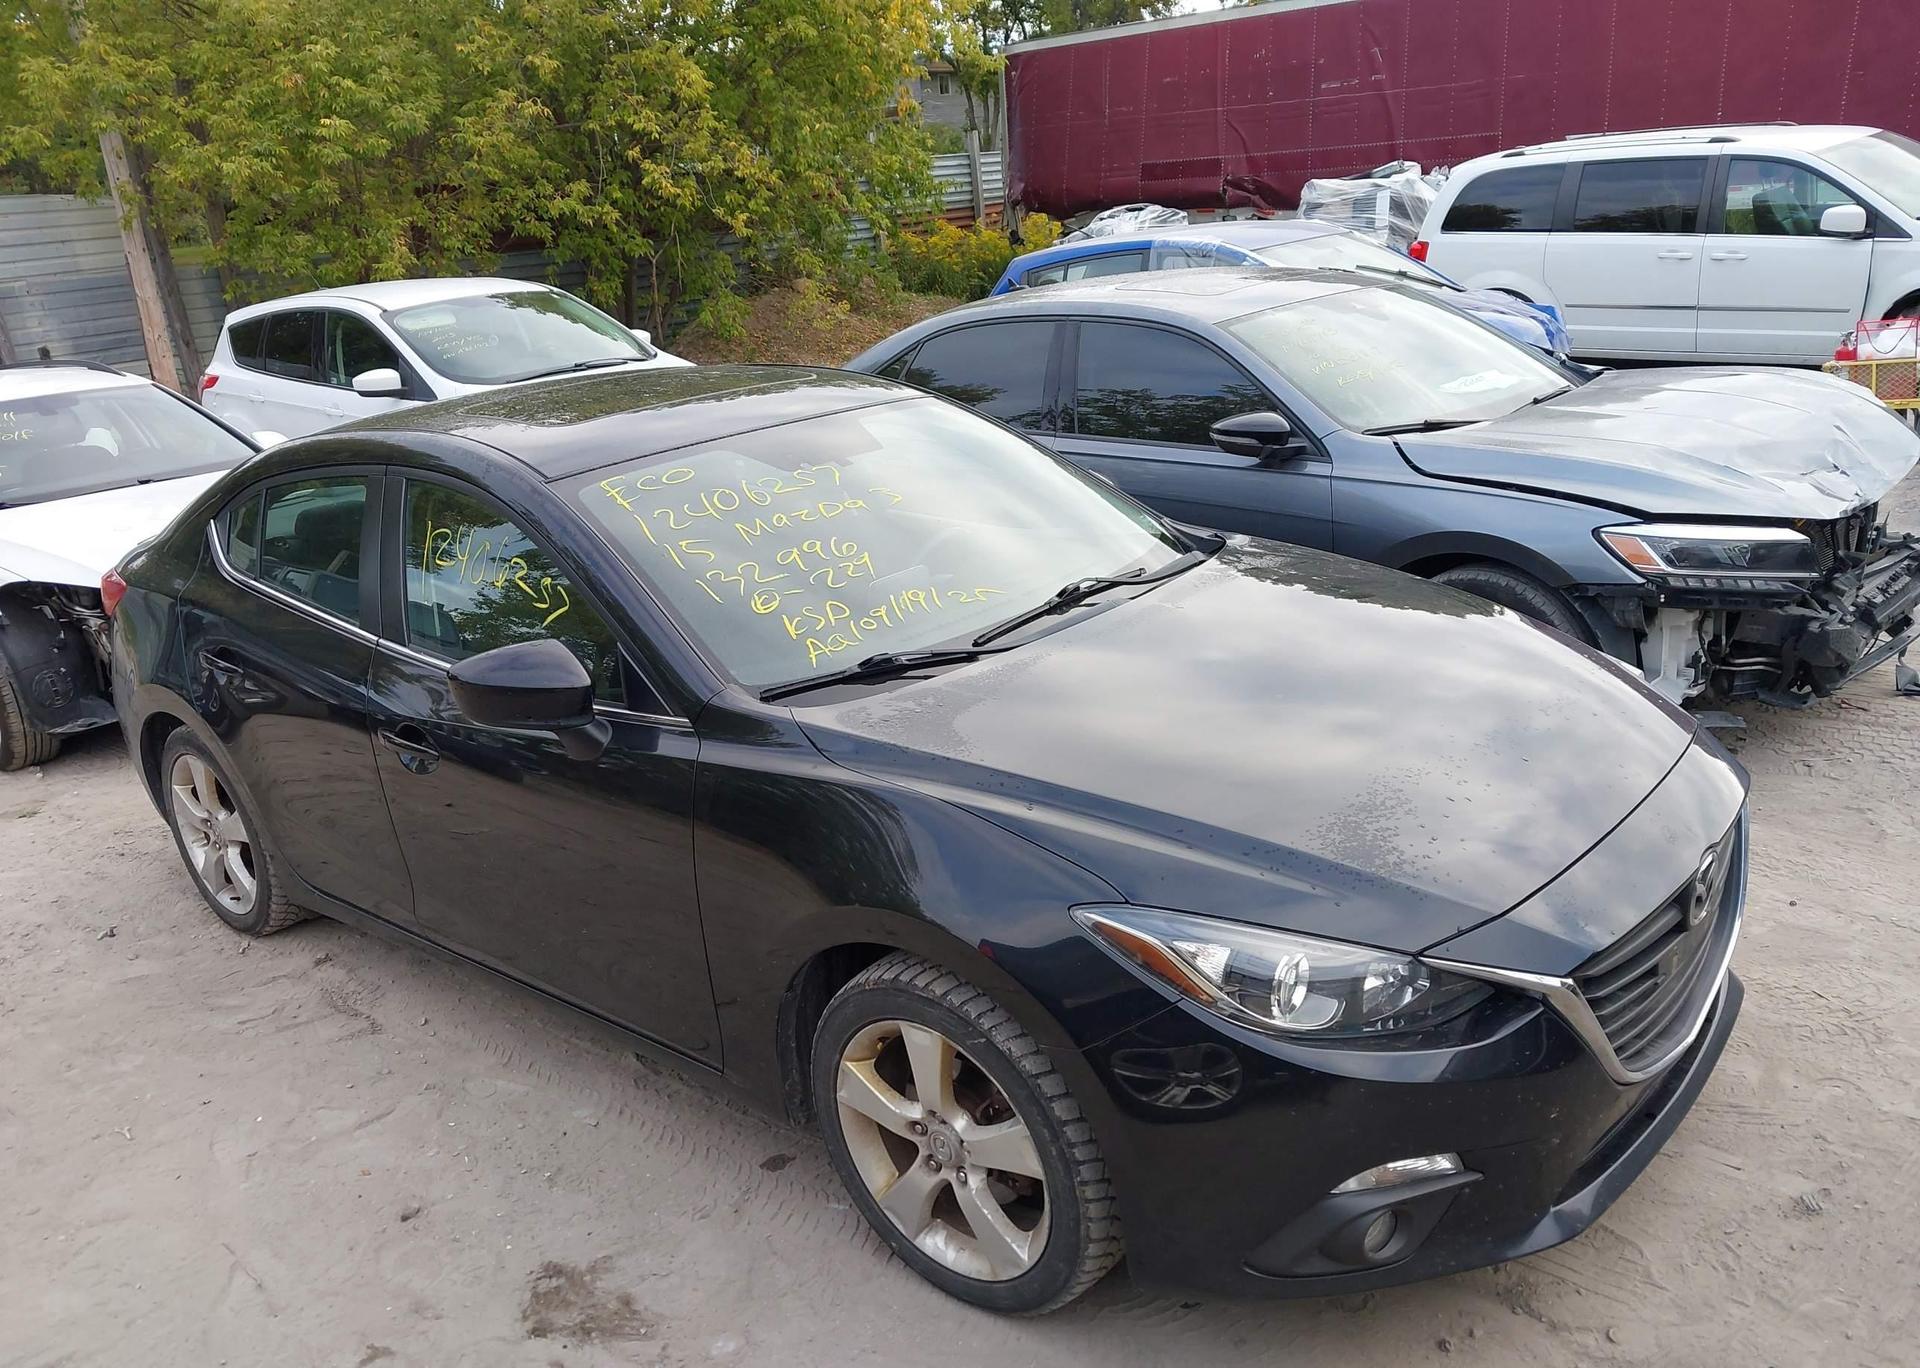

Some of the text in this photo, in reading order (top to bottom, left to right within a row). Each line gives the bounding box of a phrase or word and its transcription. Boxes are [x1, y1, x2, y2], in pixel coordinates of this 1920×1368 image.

[633, 465, 841, 546] 12406257
[663, 539, 716, 571] 15
[867, 488, 904, 503] 3
